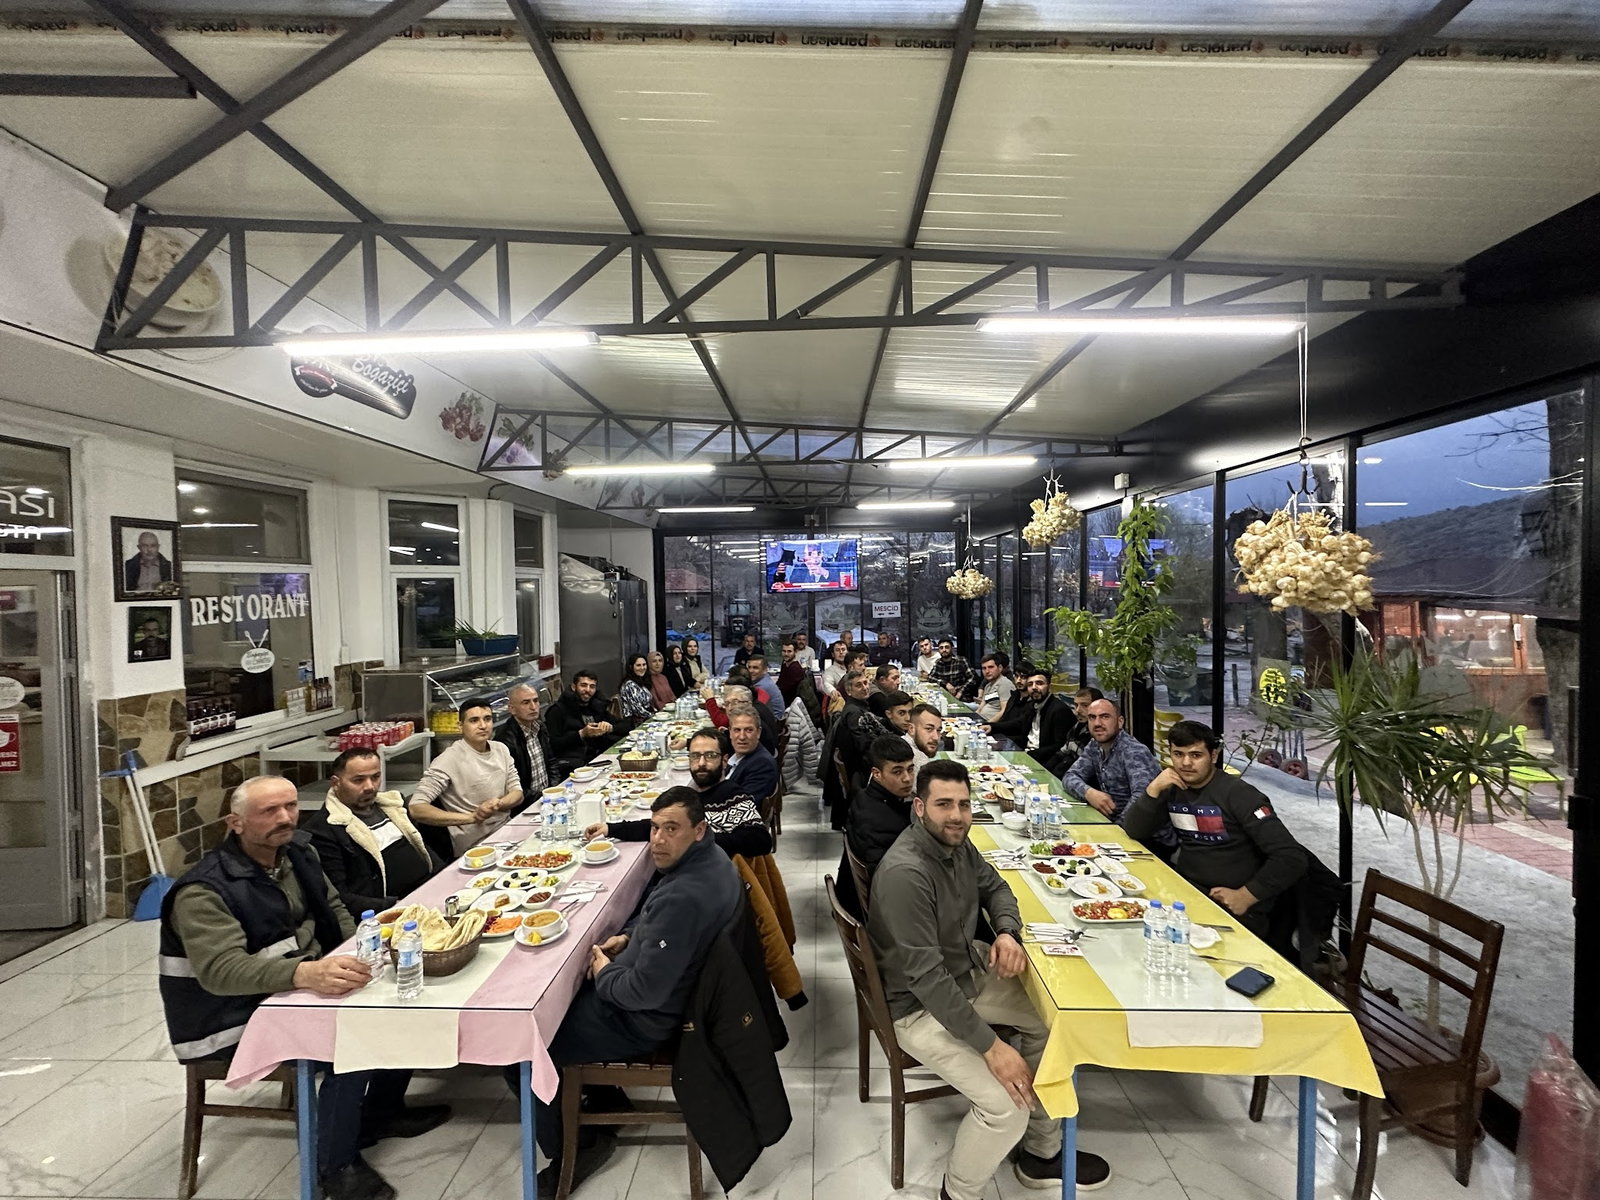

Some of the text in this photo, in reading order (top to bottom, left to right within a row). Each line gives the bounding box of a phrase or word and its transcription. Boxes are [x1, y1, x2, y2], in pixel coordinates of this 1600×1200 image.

[708, 31, 775, 46] panelsan
[801, 33, 868, 47] panelsan
[895, 38, 956, 49] anelsan
[1180, 40, 1252, 53] panelsan
[1279, 41, 1350, 56] panelsan
[190, 593, 307, 626] RESTORANT
